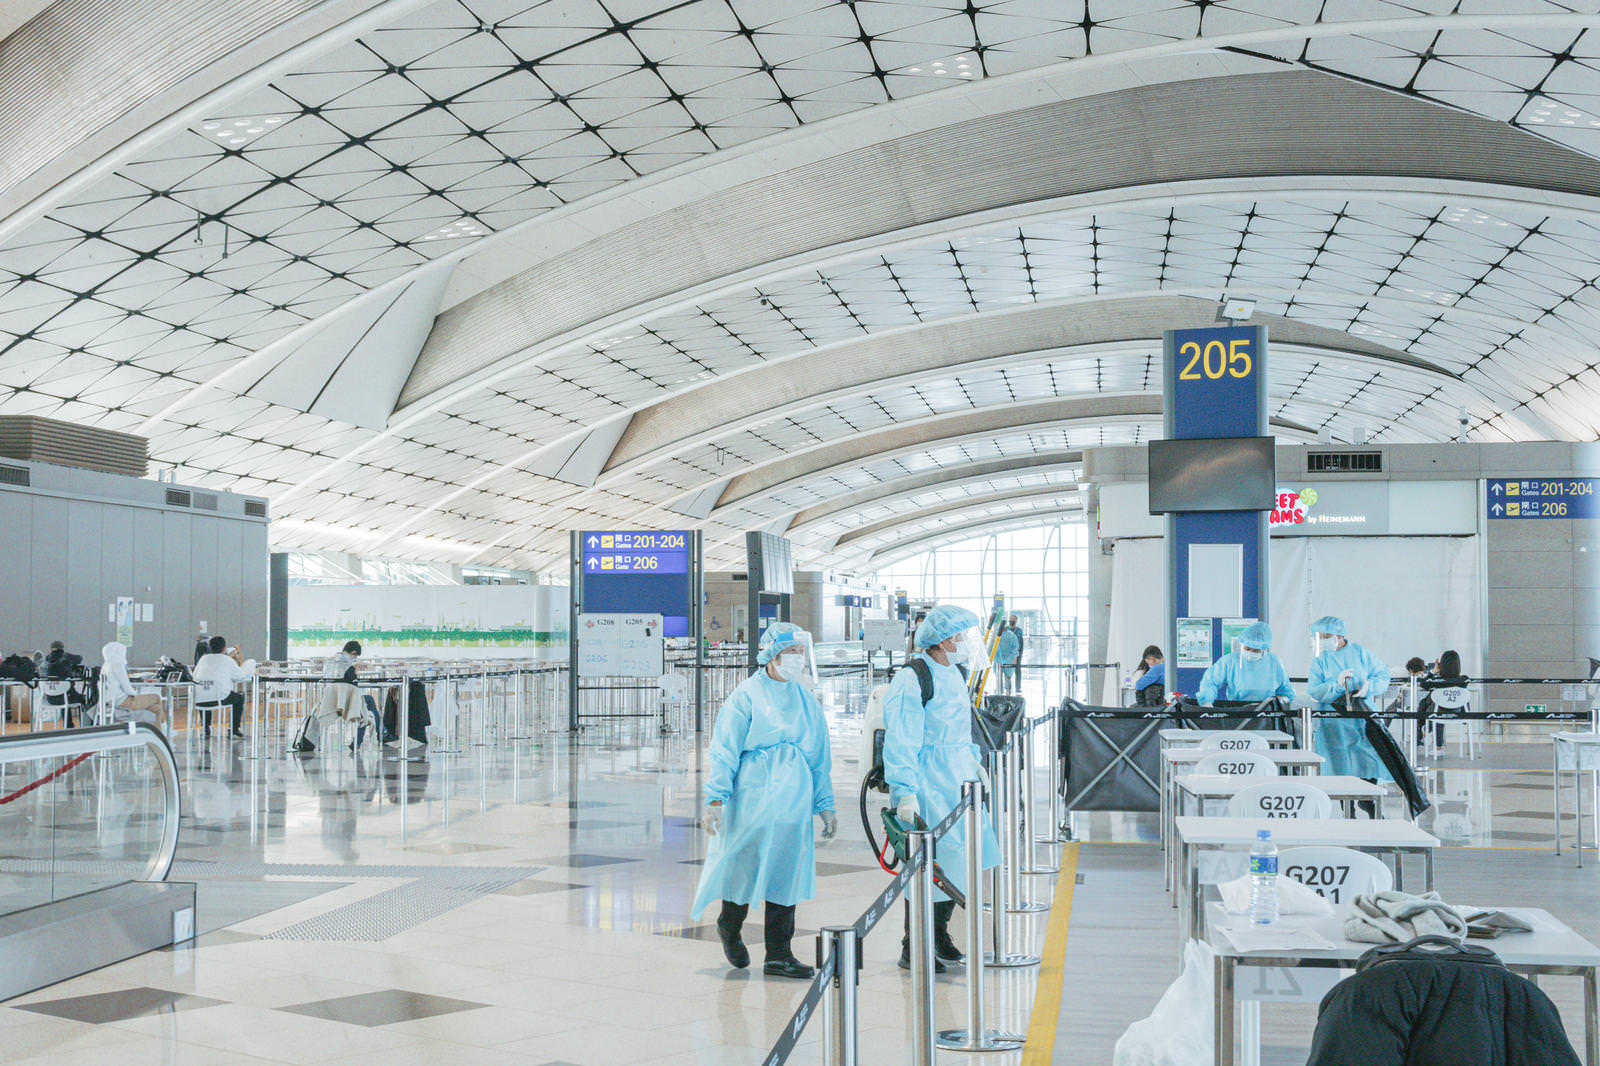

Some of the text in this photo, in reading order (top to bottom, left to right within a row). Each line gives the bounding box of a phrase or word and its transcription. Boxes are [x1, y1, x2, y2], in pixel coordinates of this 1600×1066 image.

[1179, 339, 1252, 380] 205
[1541, 482, 1593, 496] 201-204
[1276, 493, 1300, 509] ET
[1542, 502, 1568, 516] 206
[1270, 509, 1304, 524] AMS
[1308, 515, 1366, 524] by HEINEMANN
[633, 535, 685, 548] 201-204
[633, 556, 658, 569] 206
[1220, 740, 1251, 750] G207
[1218, 763, 1255, 775] G207
[1260, 796, 1305, 811] G207
[1286, 866, 1350, 886] G207
